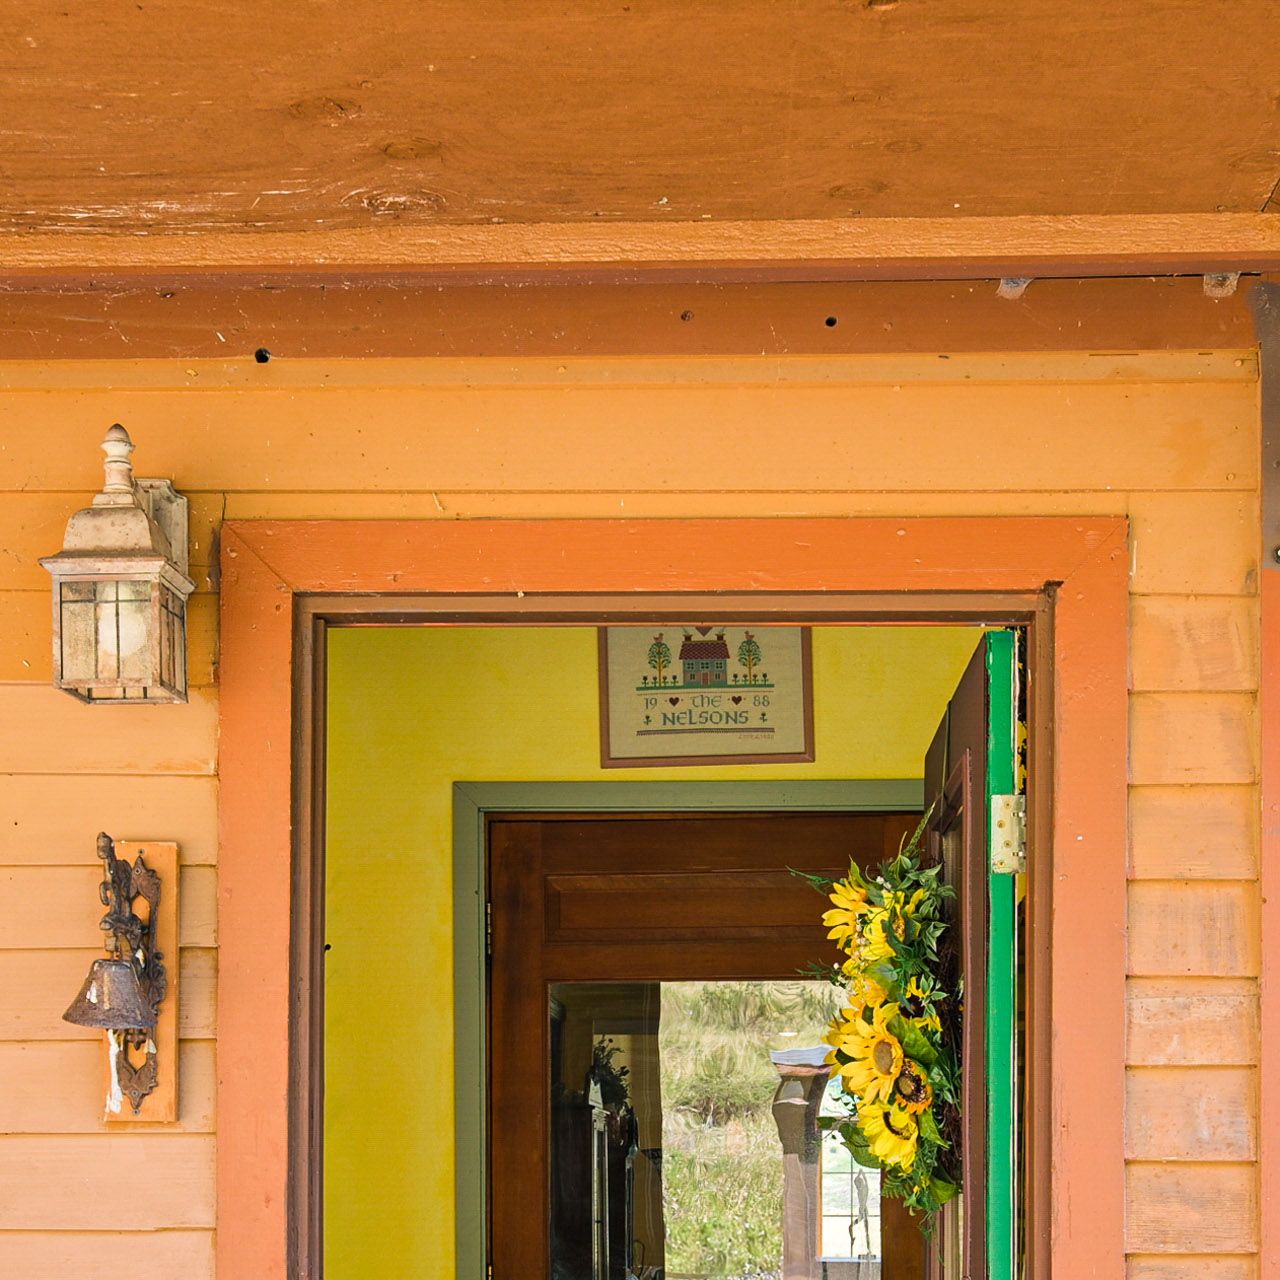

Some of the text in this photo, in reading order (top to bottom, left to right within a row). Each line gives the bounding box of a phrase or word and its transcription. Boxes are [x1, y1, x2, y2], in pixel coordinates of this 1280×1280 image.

[644, 697, 658, 709] 19
[752, 695, 770, 707] 88
[662, 709, 749, 726] NELSONS
